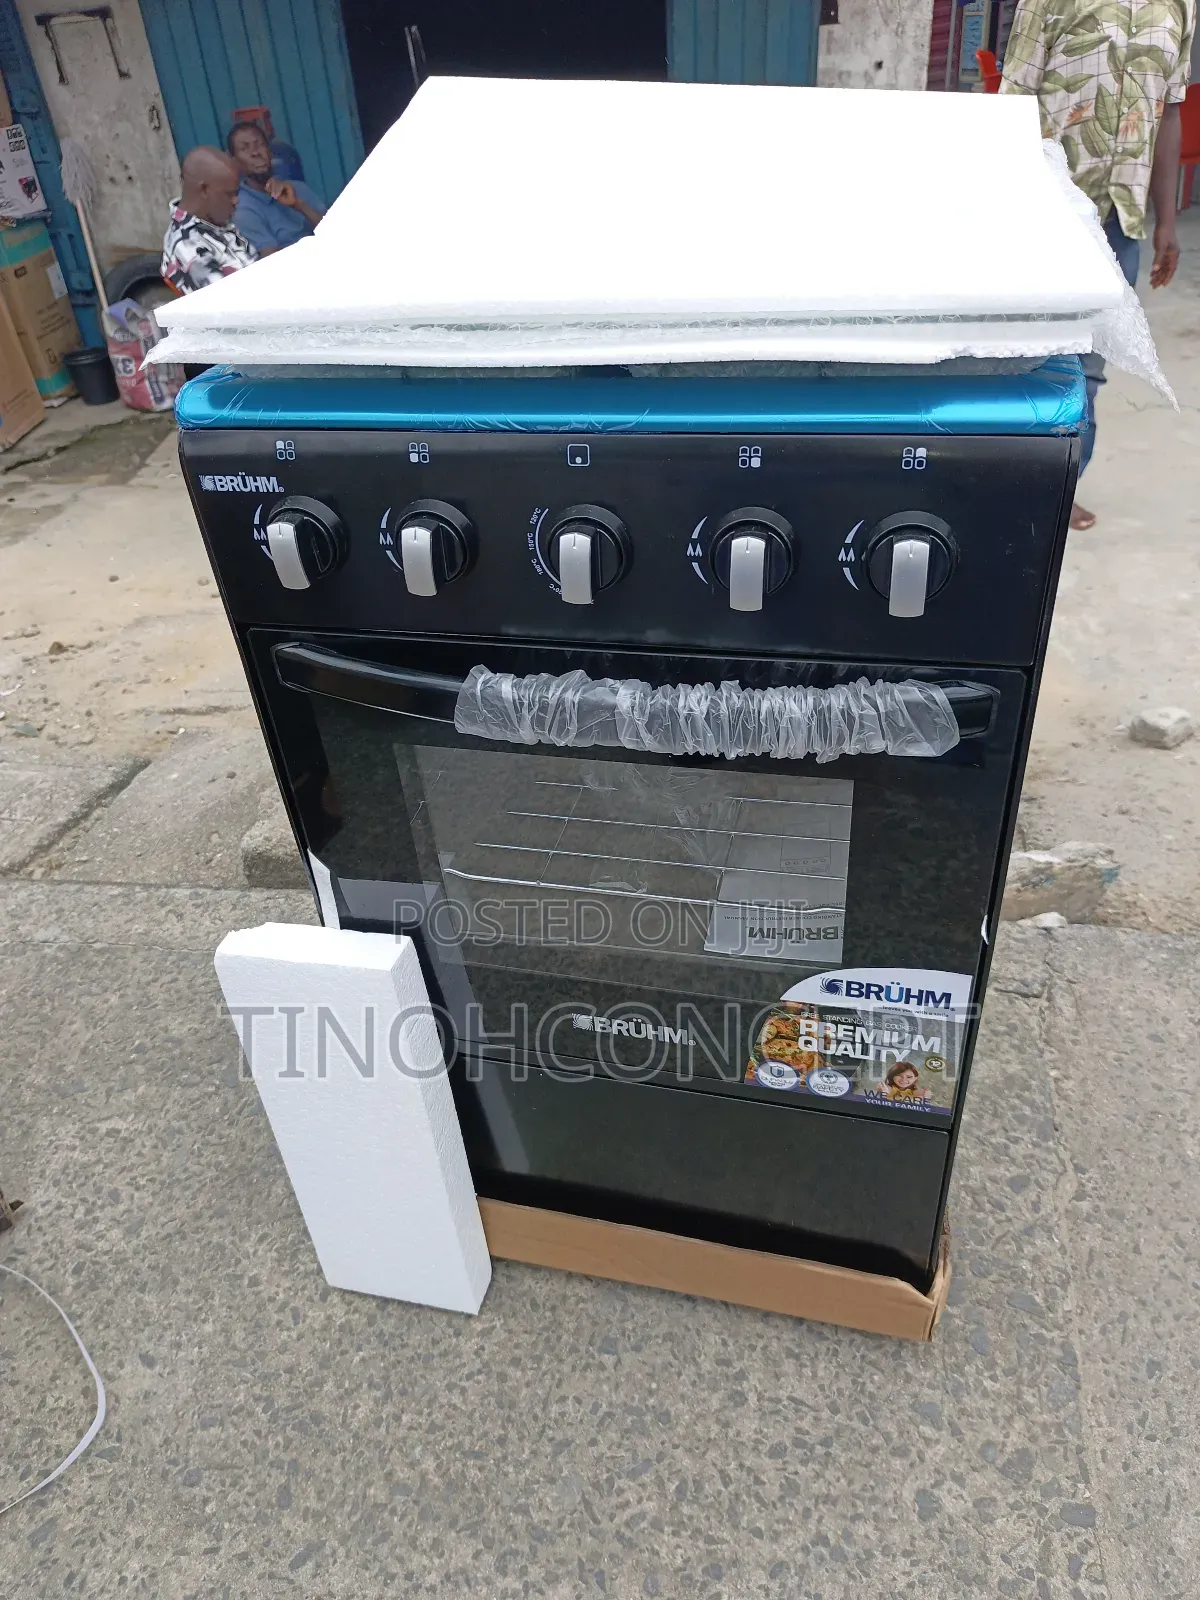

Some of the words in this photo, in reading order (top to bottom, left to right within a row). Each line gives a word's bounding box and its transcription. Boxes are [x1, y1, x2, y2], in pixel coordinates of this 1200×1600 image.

[214, 472, 280, 492] BRÜHM
[748, 926, 839, 944] BRÜHM
[844, 981, 952, 1010] BRÜHM
[822, 1014, 863, 1025] STANDING
[594, 1018, 689, 1045] BRÜHM
[800, 1018, 941, 1053] PREMIUM
[797, 1035, 911, 1062] QUALITY
[864, 1088, 889, 1099] WE
[892, 1094, 932, 1105] CARE
[865, 1098, 892, 1108] YOUR
[894, 1102, 932, 1112] FAMILY
